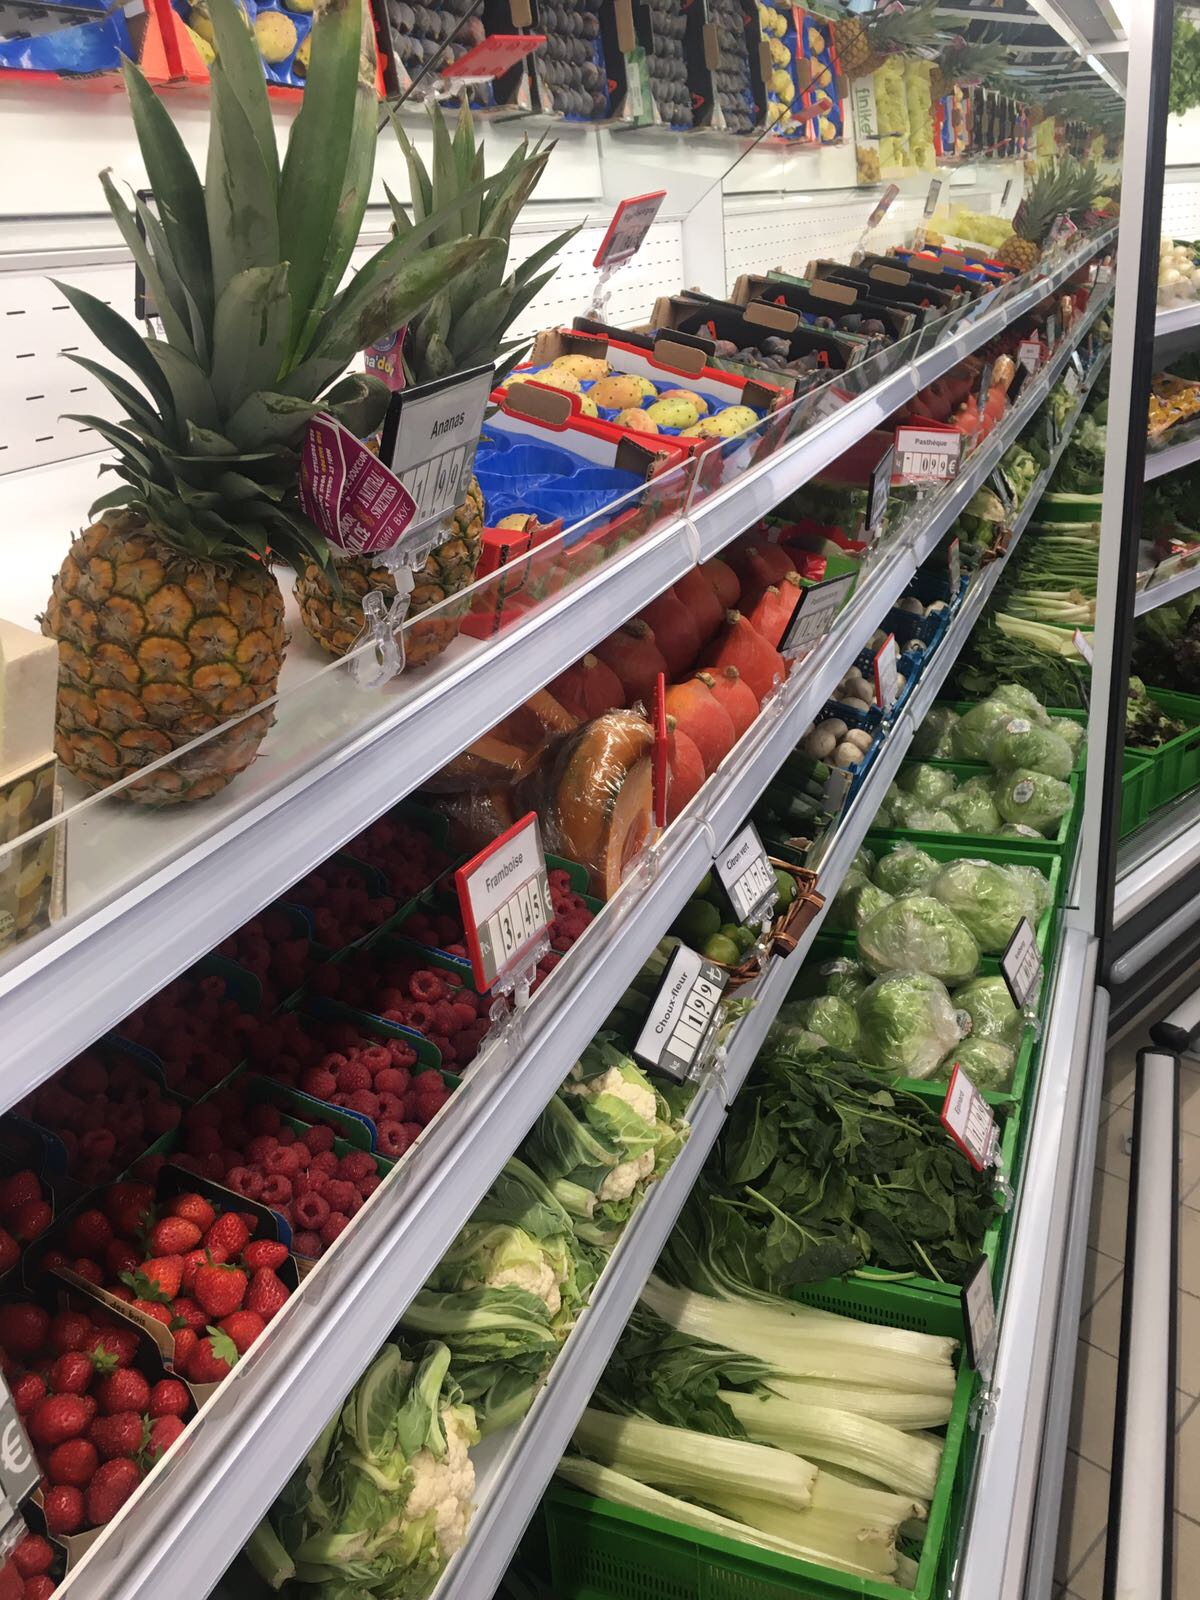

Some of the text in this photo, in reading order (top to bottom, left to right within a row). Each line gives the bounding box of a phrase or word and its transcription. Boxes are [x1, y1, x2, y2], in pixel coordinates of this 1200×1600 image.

[430, 411, 465, 439] Ananas
[948, 459, 957, 474] €
[359, 470, 385, 504] NATURAL
[370, 482, 398, 519] SWEETNESS
[393, 502, 411, 527] ВКУС
[485, 852, 523, 893] Framboise
[726, 842, 750, 870] Citron vert
[503, 893, 541, 951] 3.45
[655, 972, 688, 1035] Choux-fleur
[688, 983, 713, 1028] 1.99
[706, 967, 722, 981] €
[1, 1418, 32, 1475] €
